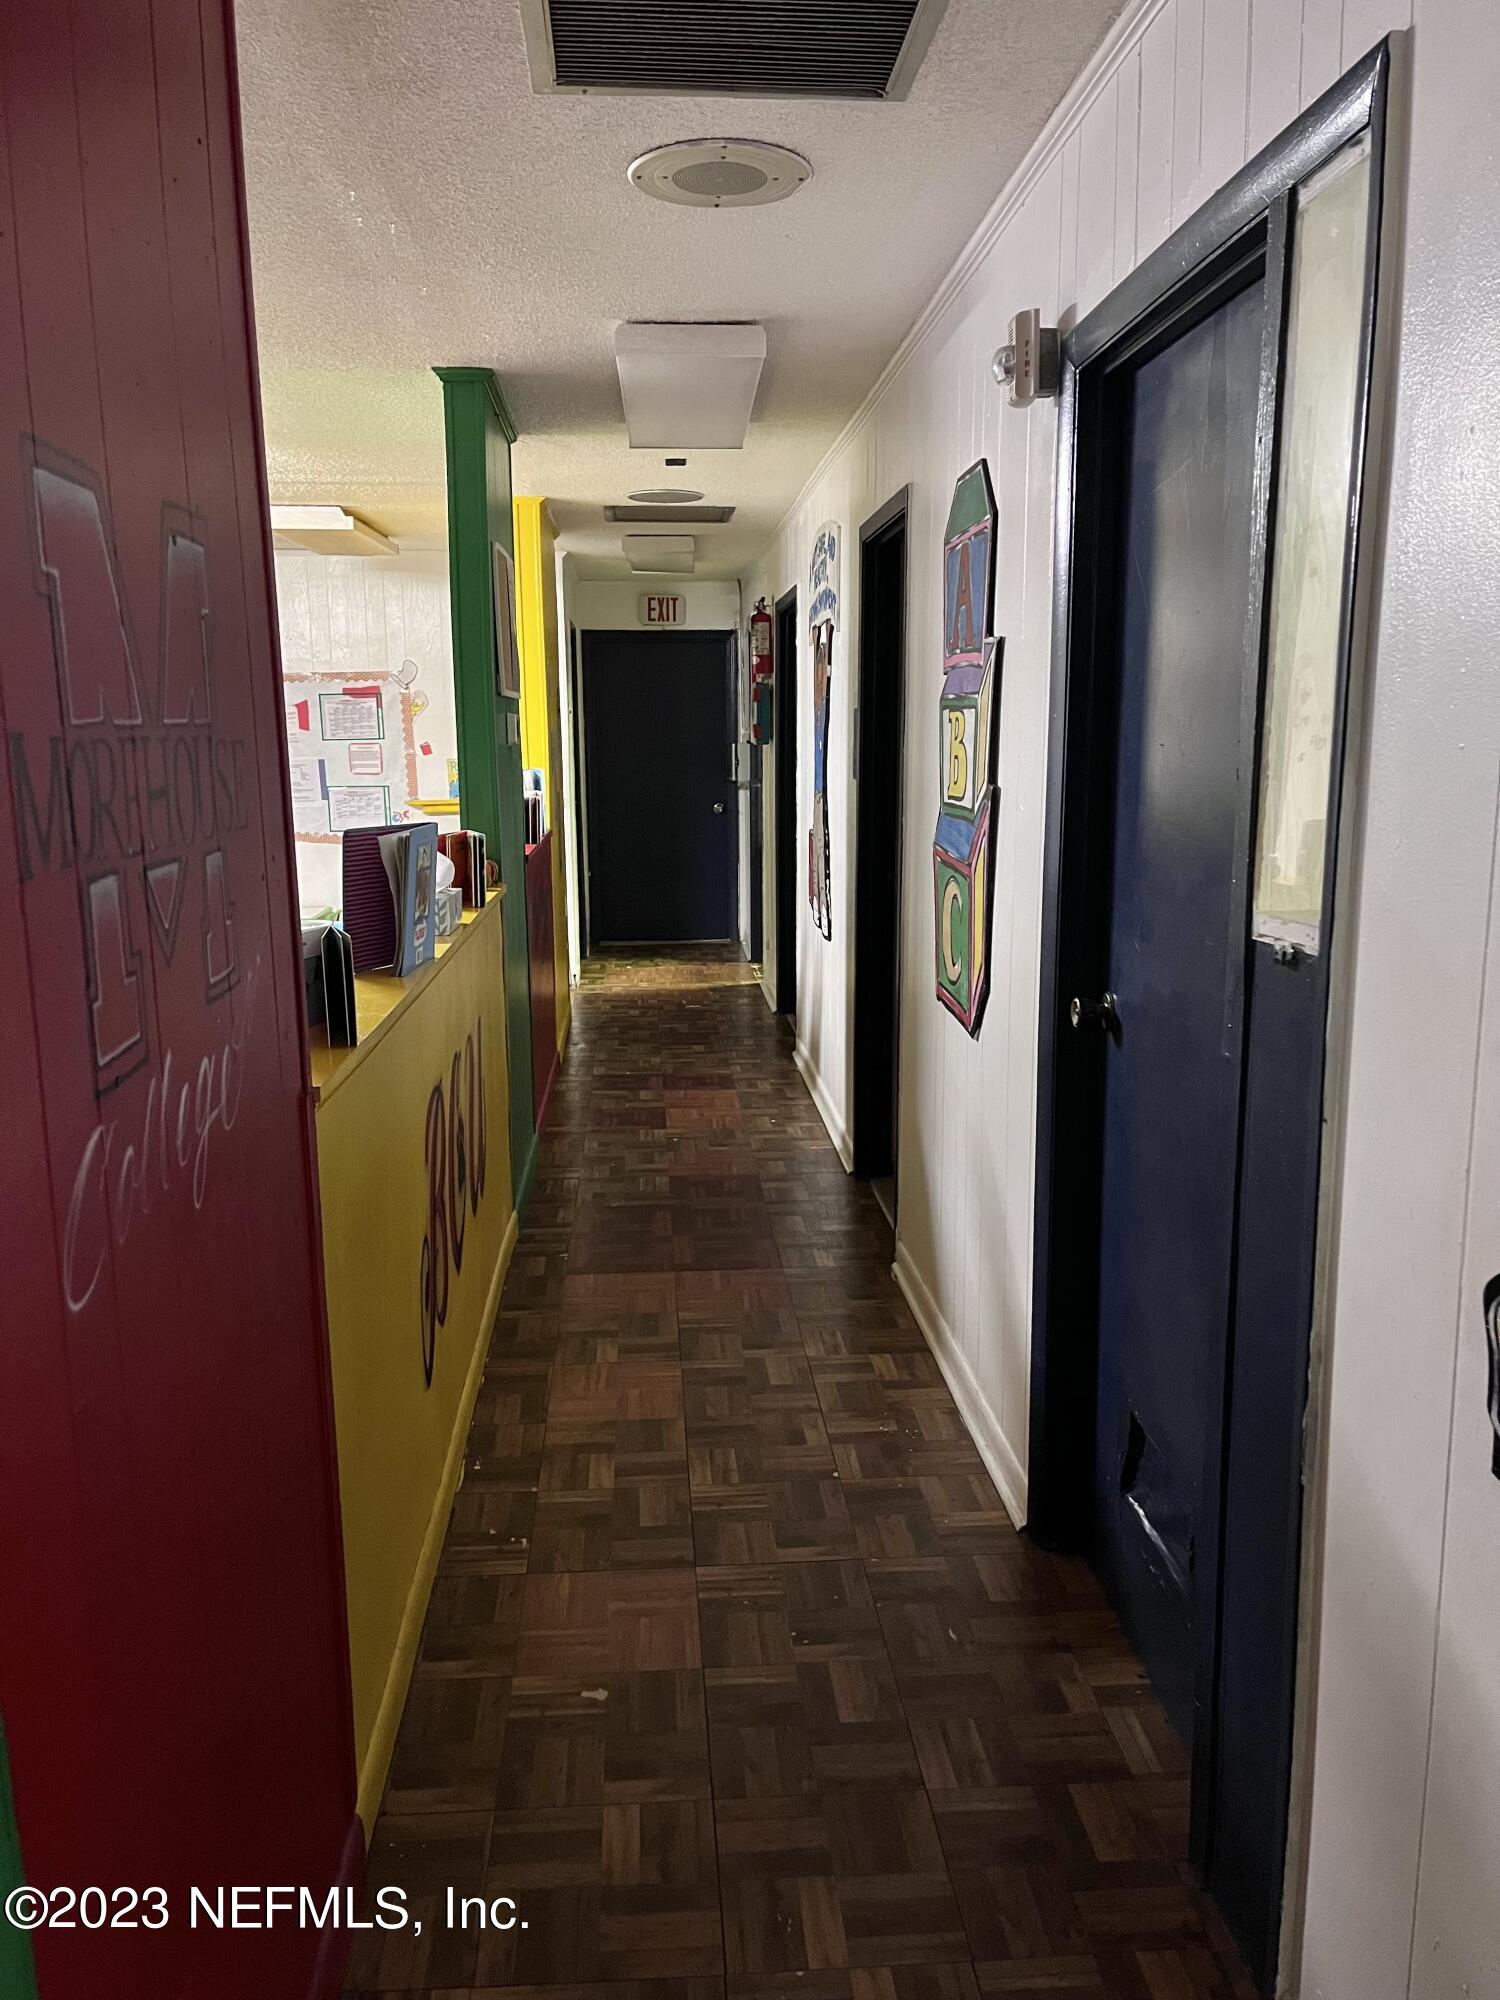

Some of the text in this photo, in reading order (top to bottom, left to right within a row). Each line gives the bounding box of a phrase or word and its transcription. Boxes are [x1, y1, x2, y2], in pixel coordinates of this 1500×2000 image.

[1024, 339, 1032, 379] FIRE
[647, 597, 678, 622] EXIT
[950, 541, 975, 649] A
[948, 708, 968, 801] B
[942, 875, 963, 986] C
